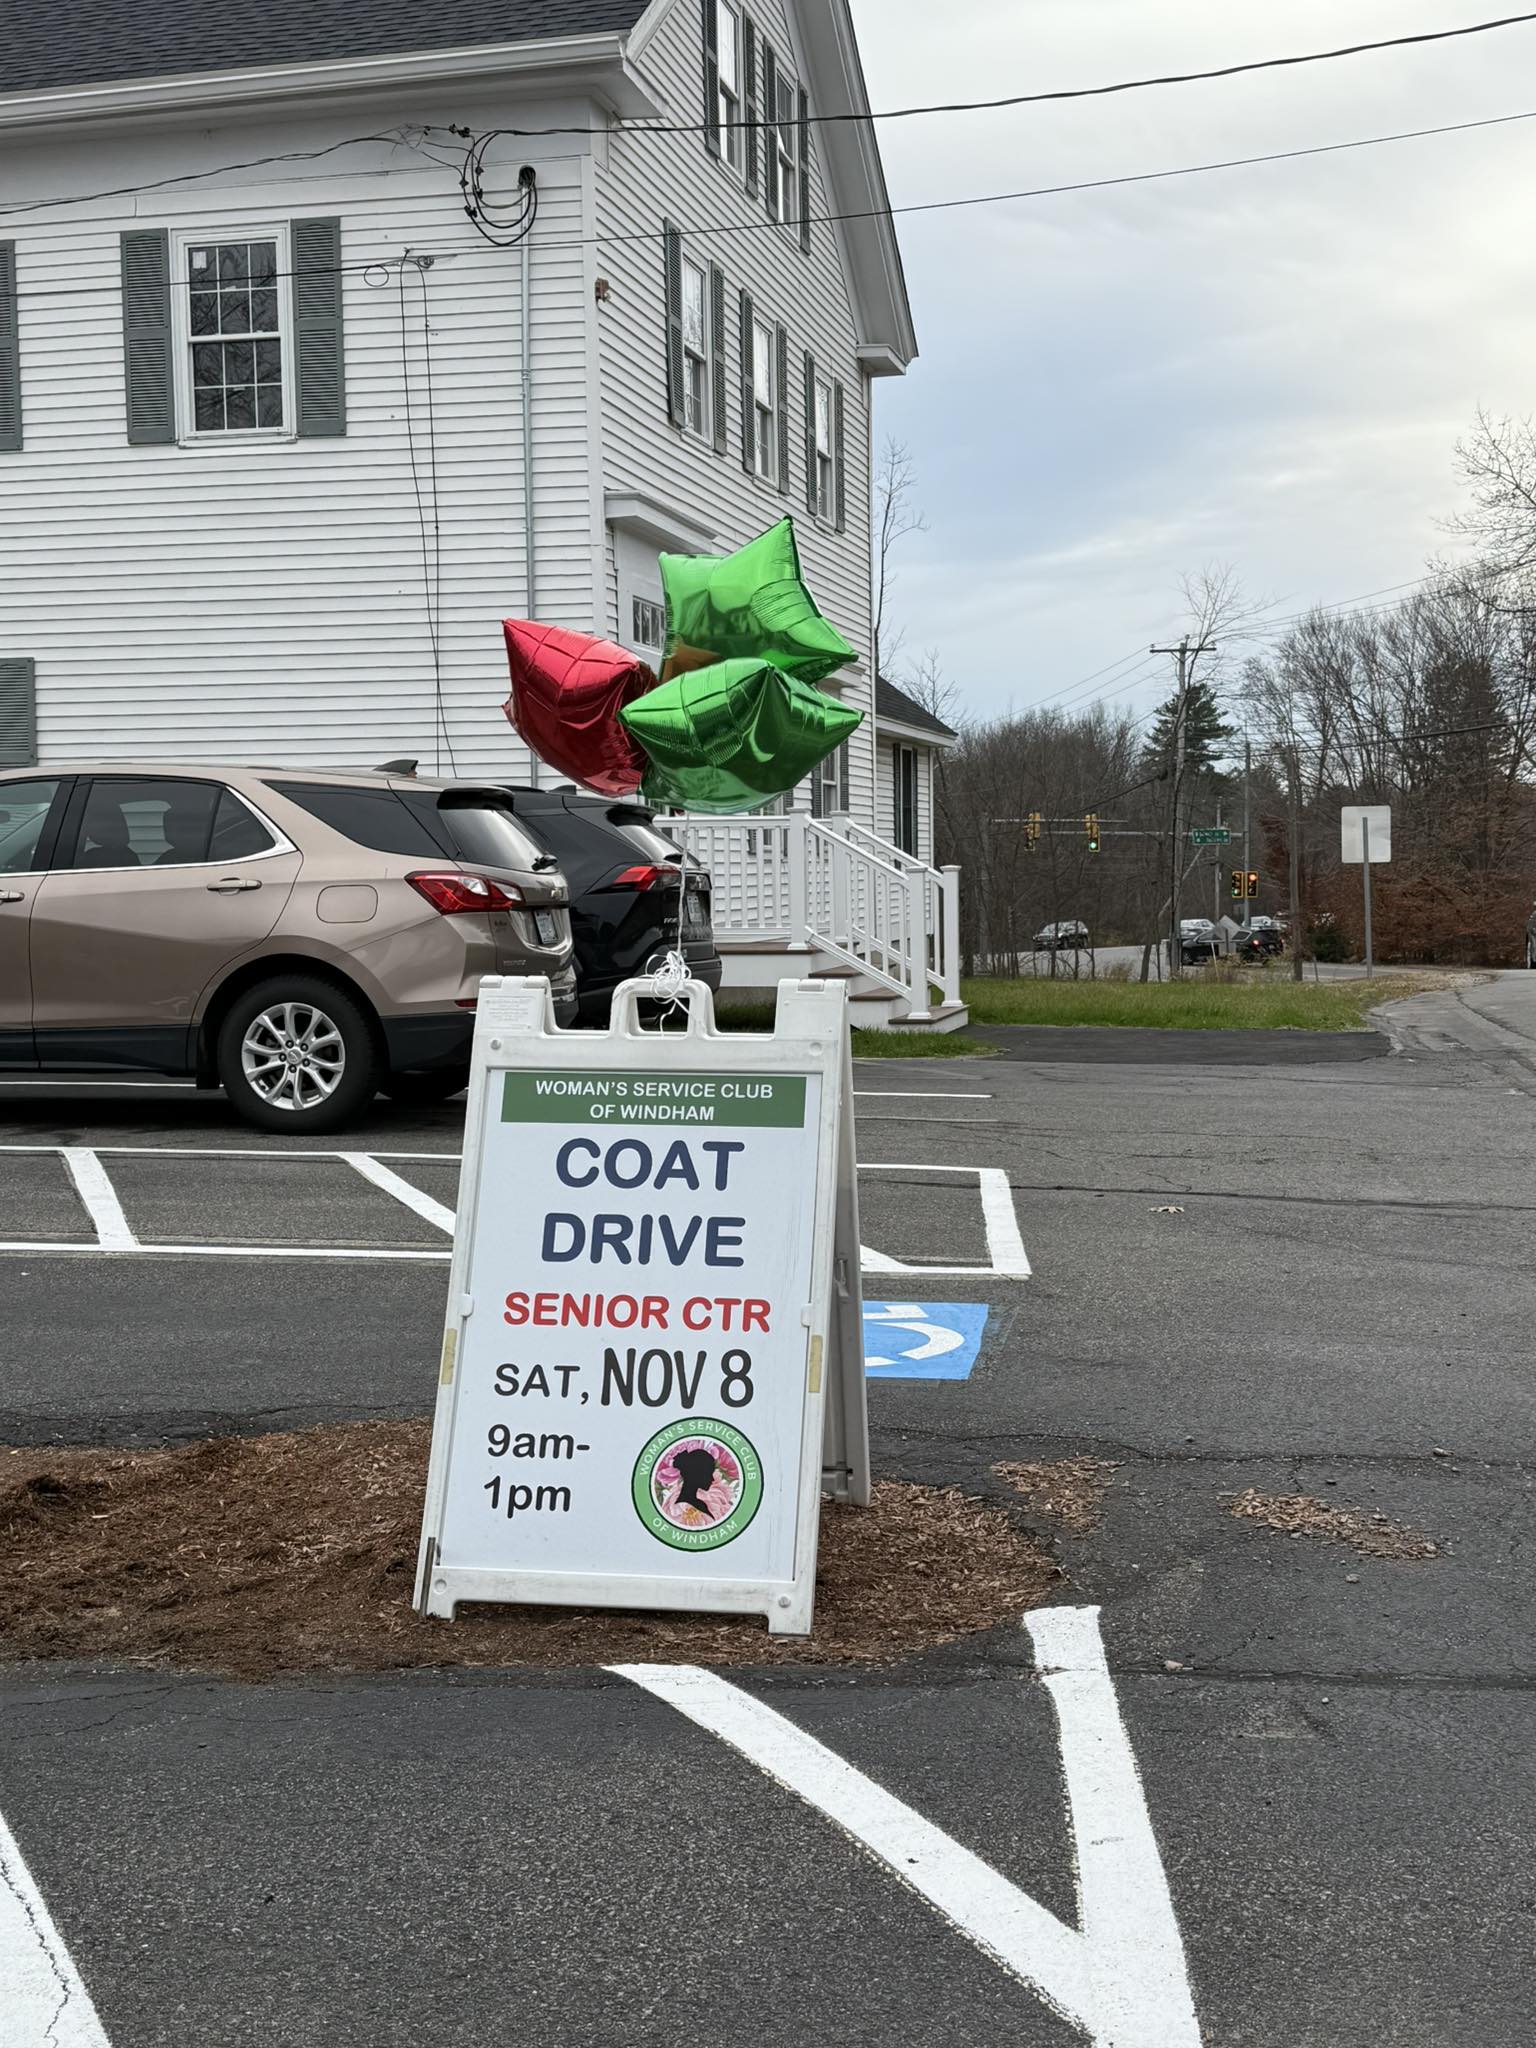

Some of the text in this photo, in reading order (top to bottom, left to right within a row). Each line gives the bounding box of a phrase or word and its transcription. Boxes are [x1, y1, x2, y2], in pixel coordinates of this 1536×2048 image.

[535, 1079, 773, 1099] WOMAN'S SERVICE CLUB
[590, 1104, 715, 1121] OF WINDHAM
[556, 1137, 745, 1191] COAT
[541, 1212, 746, 1267] DRIVE
[503, 1292, 771, 1333] SENIOR CTR
[494, 1347, 754, 1409] SAT, NOV 8
[487, 1424, 590, 1459] 9am-
[640, 1421, 757, 1480] WOMAN'S SERVICE CLUB
[483, 1475, 571, 1519] 1pm
[652, 1517, 738, 1544] OF WINDHAM
